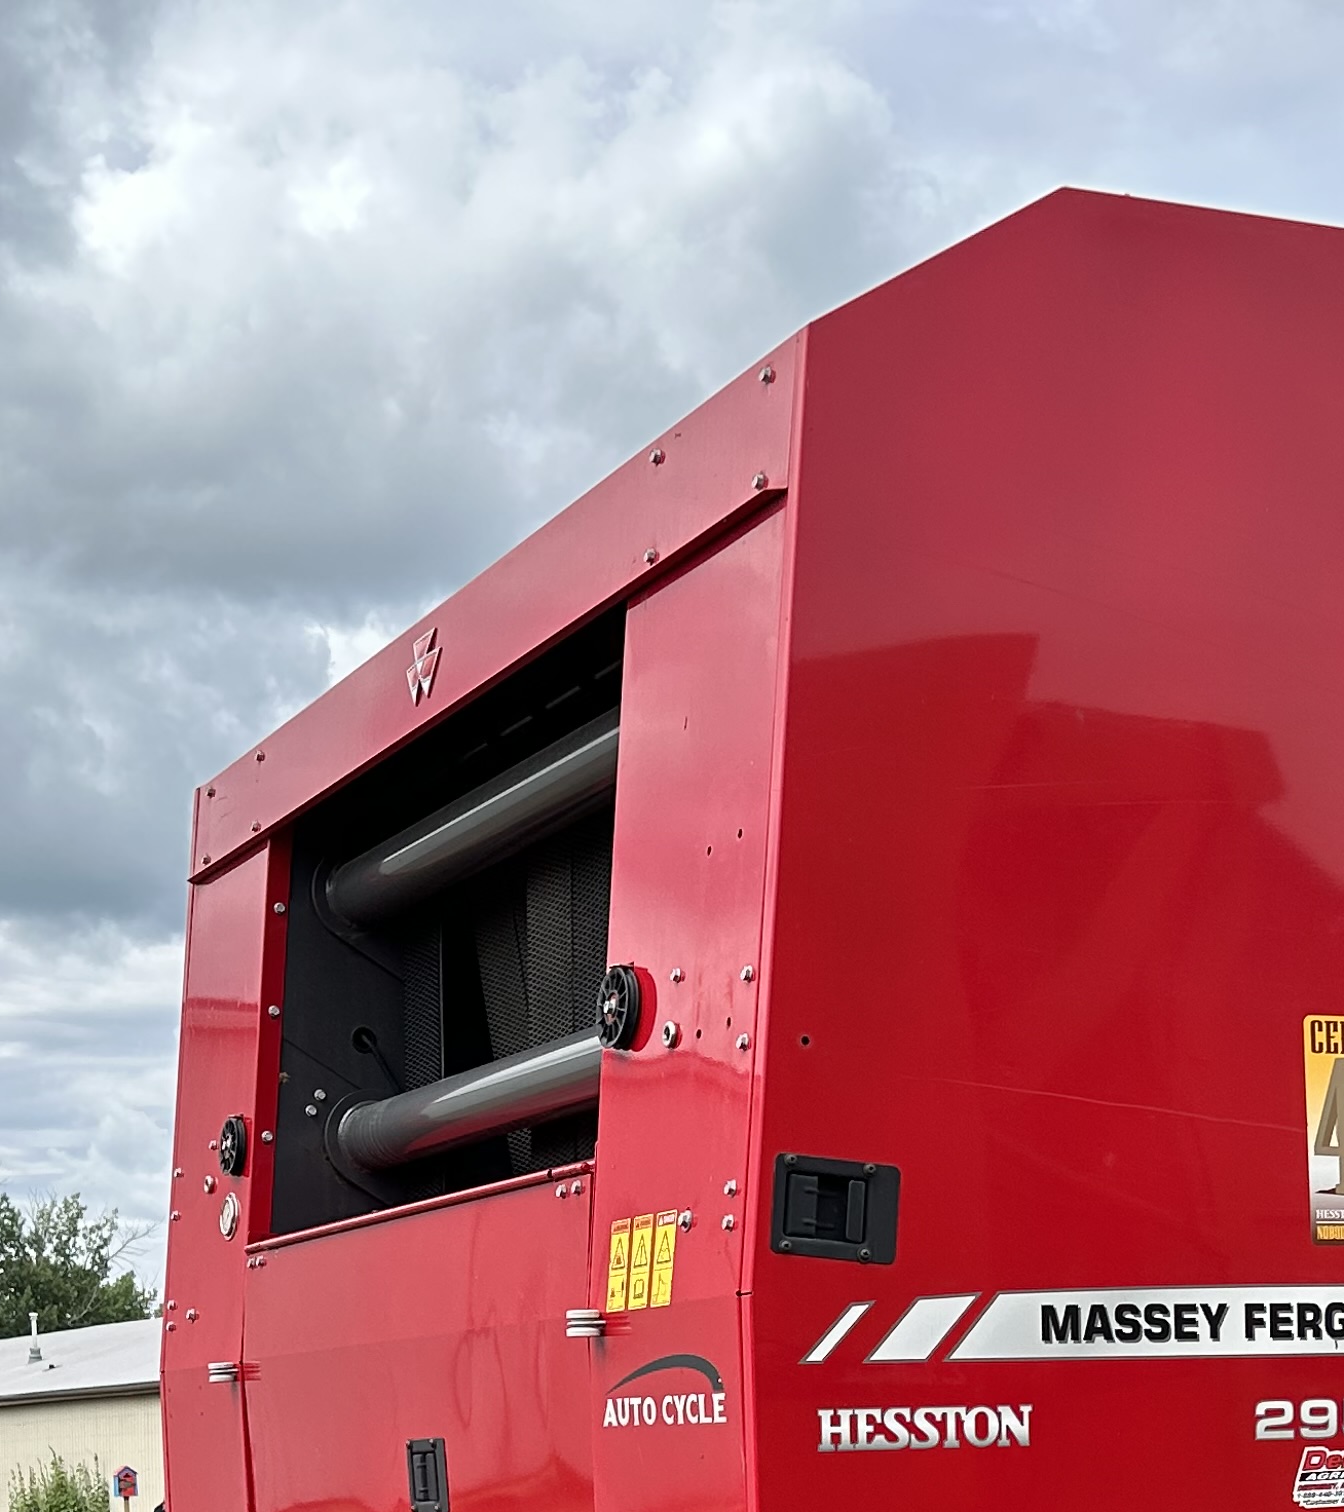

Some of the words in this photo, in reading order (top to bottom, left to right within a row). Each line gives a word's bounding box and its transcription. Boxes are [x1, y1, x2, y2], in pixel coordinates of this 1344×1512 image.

[1040, 1303, 1228, 1344] MASSEY
[602, 1396, 657, 1427] AUTO
[662, 1392, 728, 1425] CYCLE
[817, 1404, 1033, 1452] HESSTON
